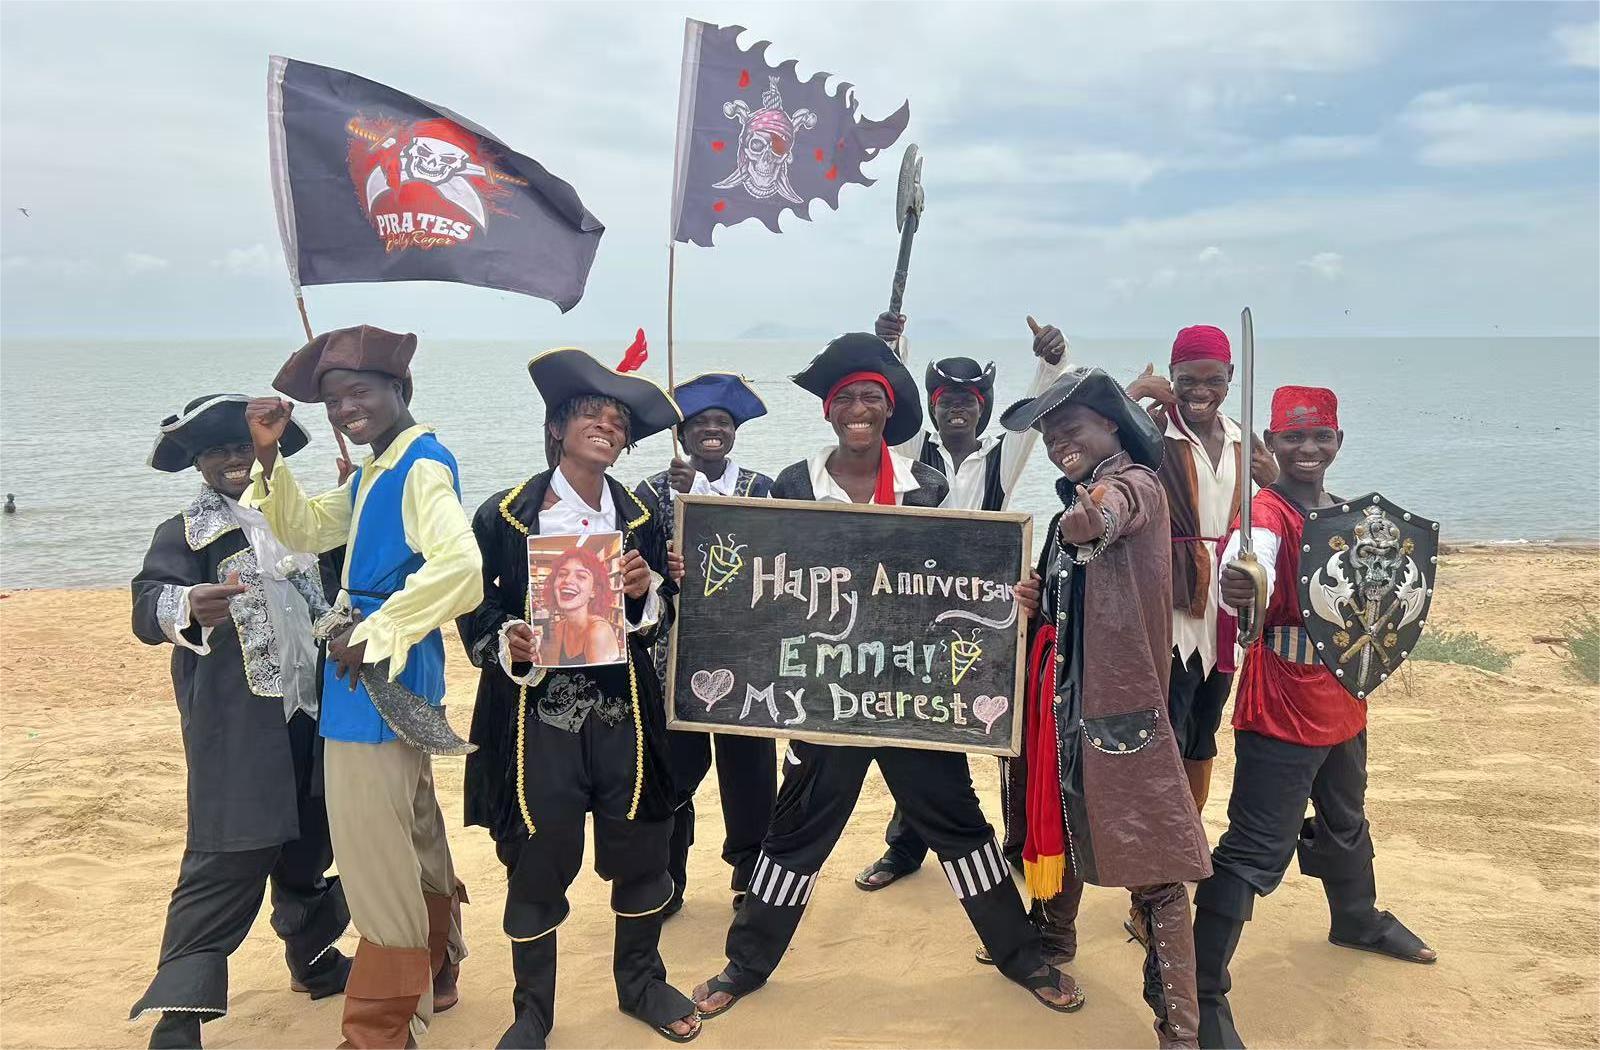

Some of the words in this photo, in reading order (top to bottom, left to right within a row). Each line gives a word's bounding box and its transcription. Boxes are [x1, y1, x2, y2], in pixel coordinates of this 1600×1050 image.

[376, 212, 472, 240] PIRATES
[411, 230, 453, 248] Roger
[751, 552, 858, 641] Happy
[778, 634, 937, 684] Emma!
[739, 682, 806, 726] My
[828, 682, 967, 726] Dearest
